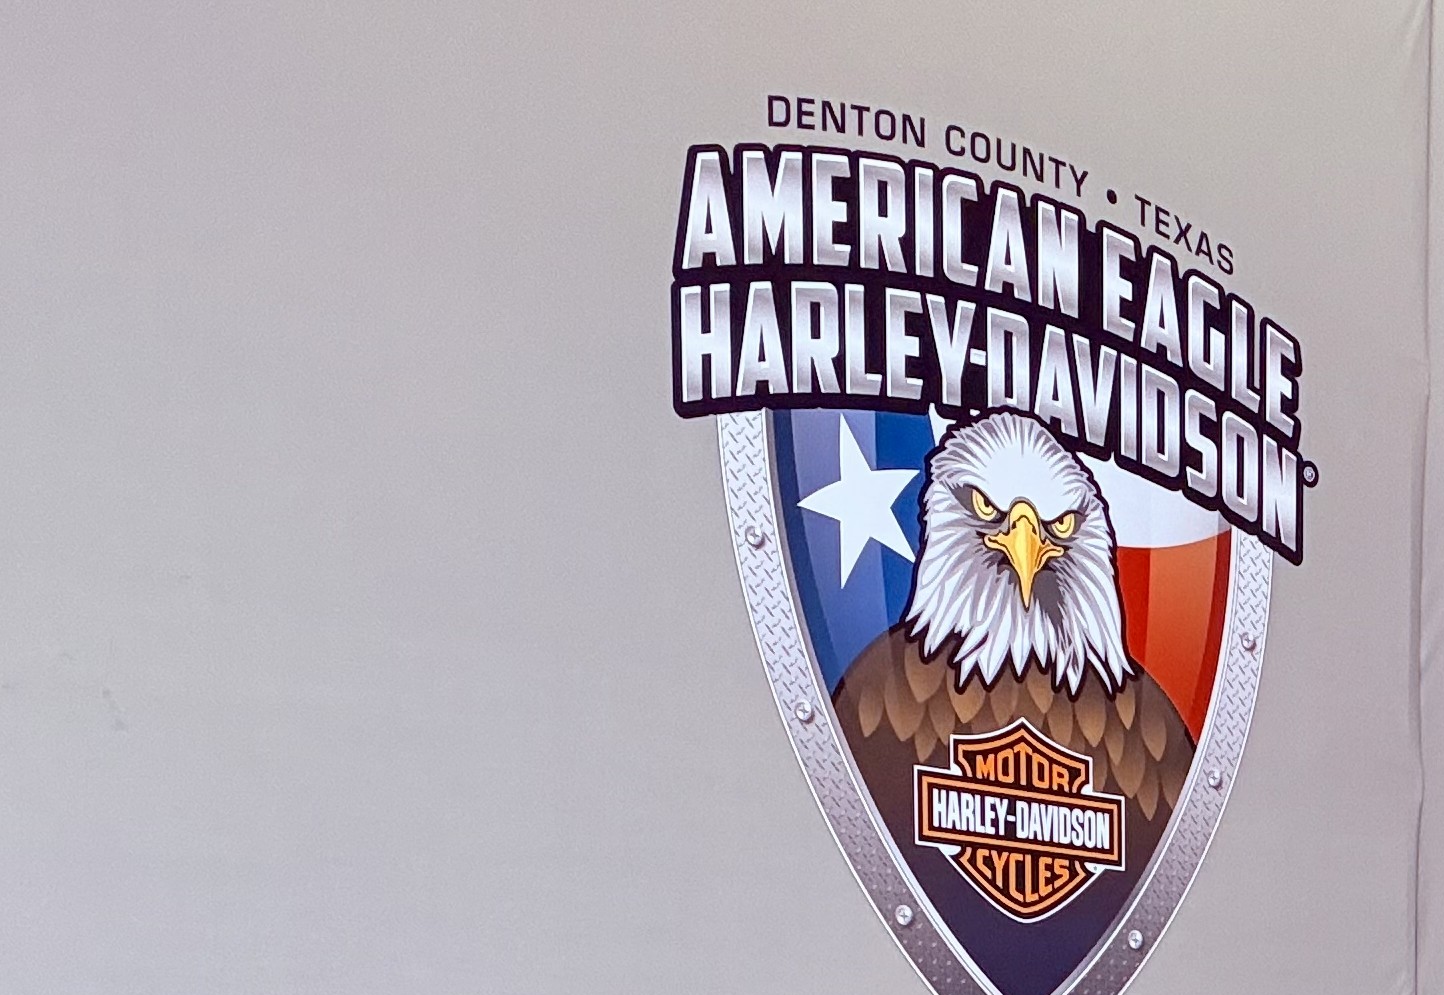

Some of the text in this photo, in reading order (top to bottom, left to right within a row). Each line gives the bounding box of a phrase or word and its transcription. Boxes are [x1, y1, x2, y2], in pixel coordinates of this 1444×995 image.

[767, 95, 1235, 275] DENTON COUNTY TEXAS
[680, 149, 1299, 437] AMERICAN EAGLE
[975, 741, 1070, 793] MOTOR
[932, 787, 1111, 850] HARLEY-DAVIDSON
[975, 847, 1070, 903] CYCLES
